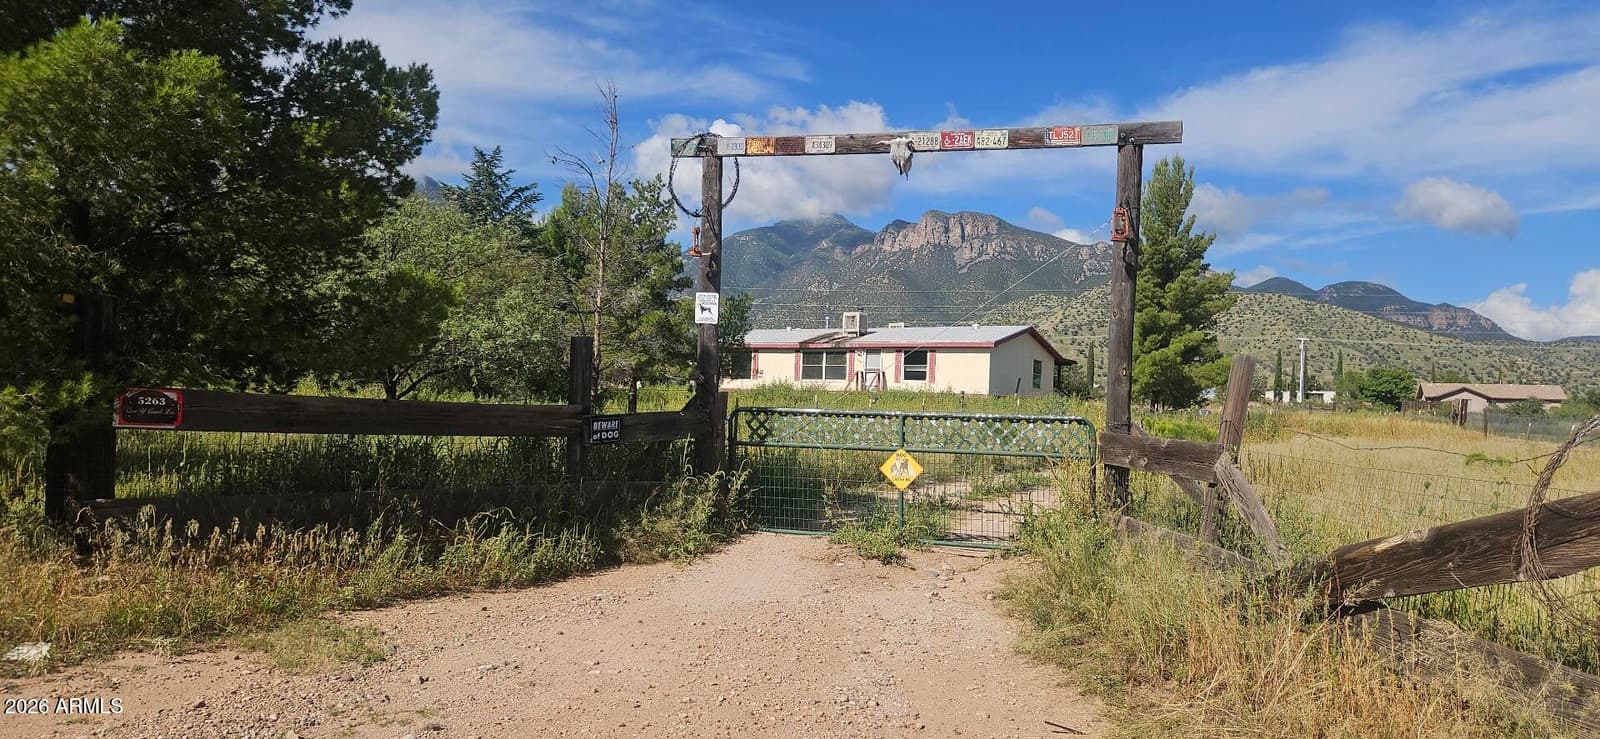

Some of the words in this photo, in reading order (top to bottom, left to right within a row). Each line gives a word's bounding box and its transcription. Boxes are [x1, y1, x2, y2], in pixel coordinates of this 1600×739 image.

[137, 396, 166, 406] 5263
[593, 420, 619, 431] BEWARE
[593, 432, 601, 440] of
[601, 430, 619, 439] DOG
